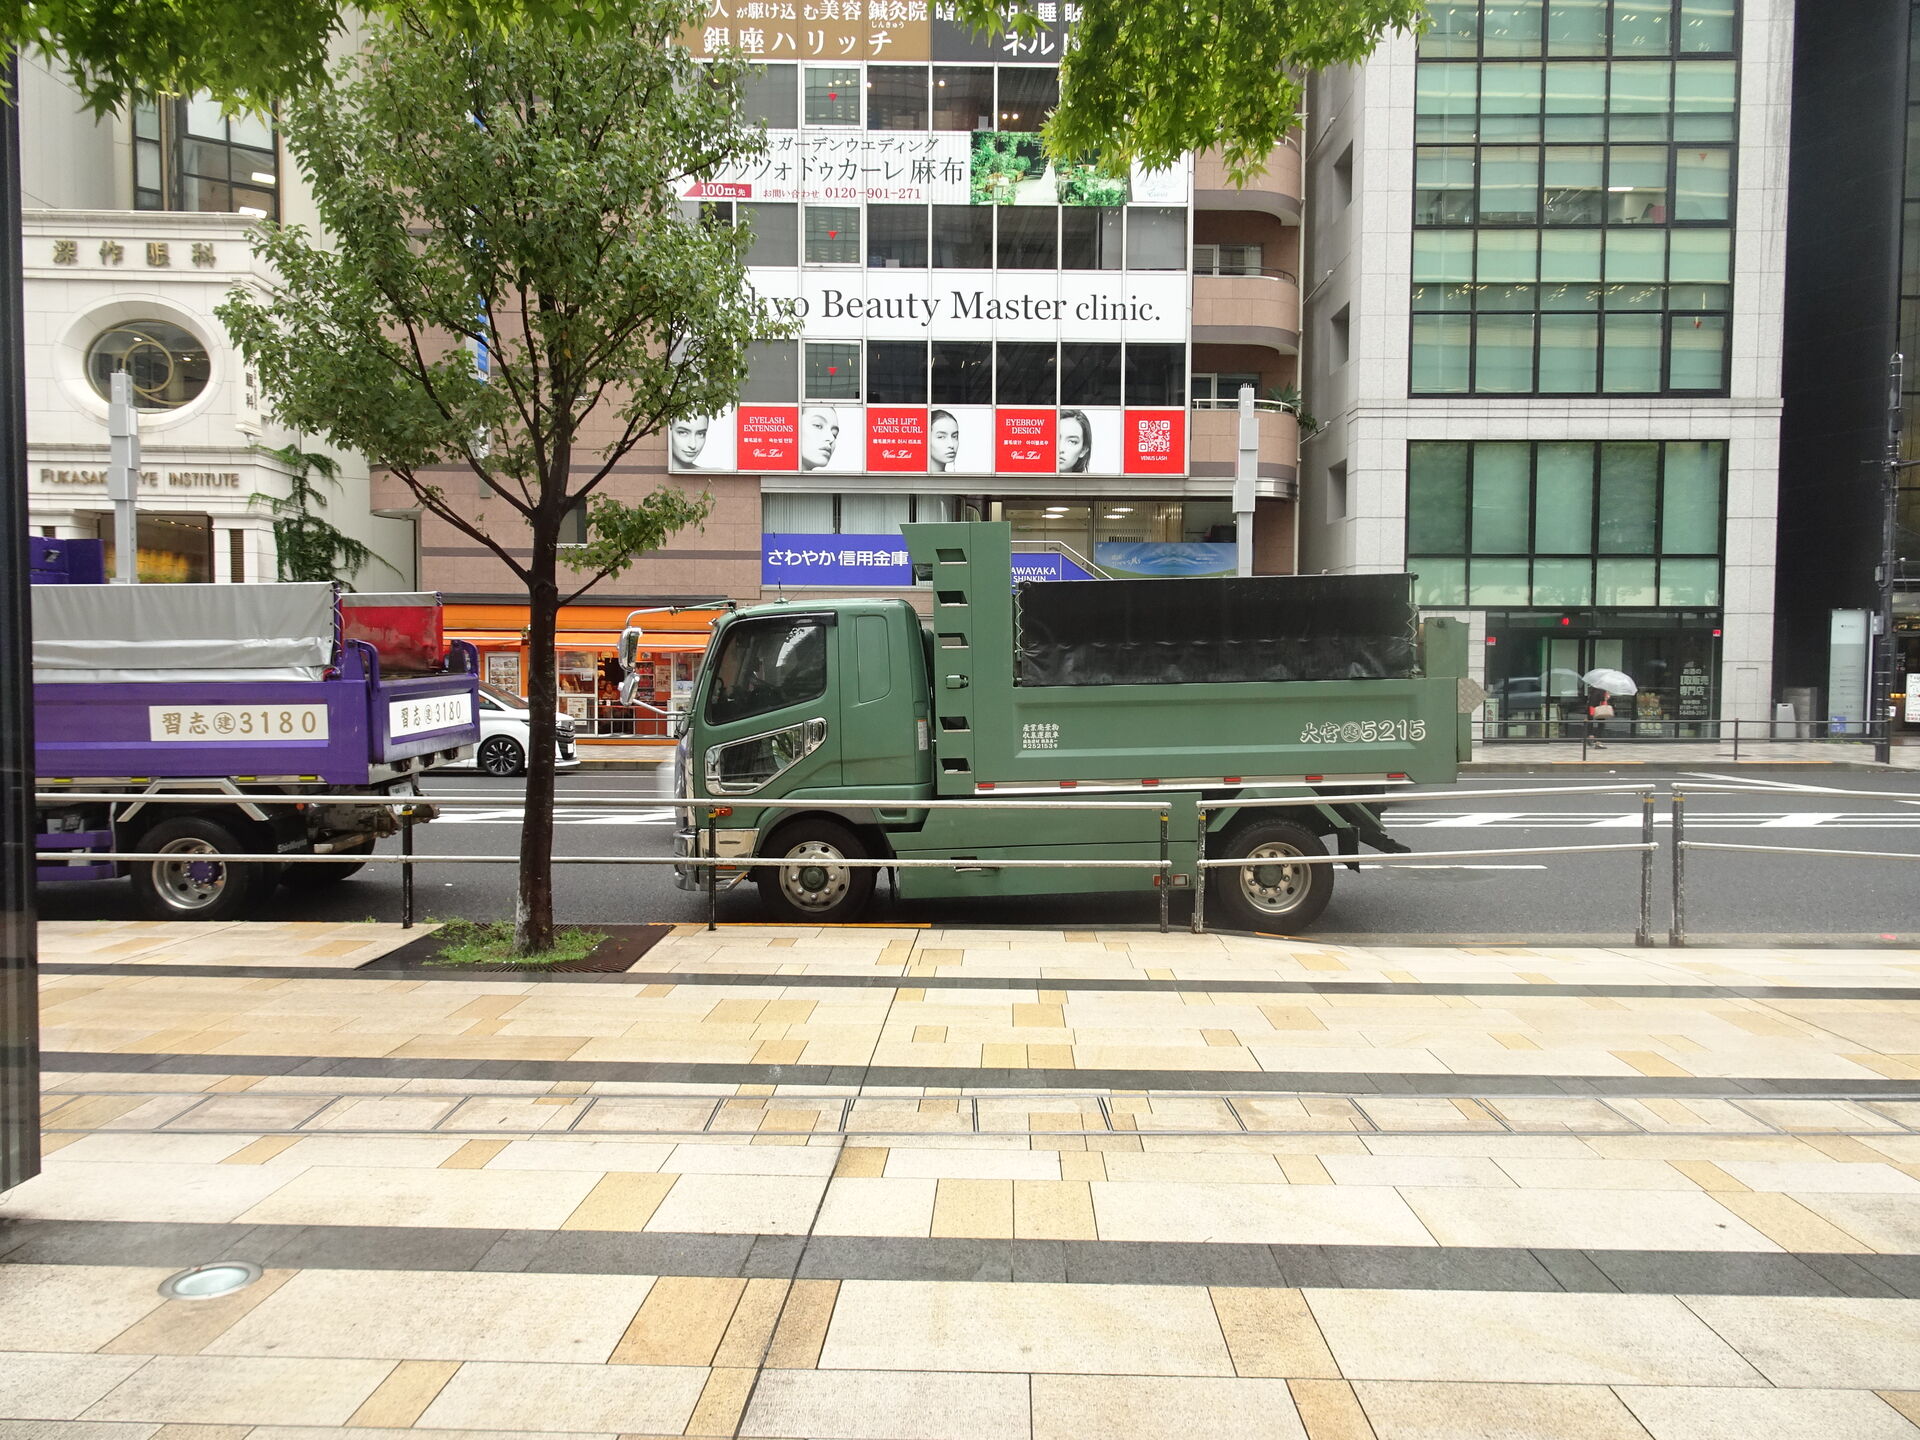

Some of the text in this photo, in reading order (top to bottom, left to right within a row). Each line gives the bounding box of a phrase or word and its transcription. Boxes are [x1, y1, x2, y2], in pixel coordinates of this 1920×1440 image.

[704, 0, 927, 22] 人が駆け込む美容鍼灸院
[704, 26, 892, 55] 銀座ハリッチ
[763, 187, 921, 199] お問い合わせ 0120-901-271
[822, 289, 940, 327] Beauty
[950, 290, 1067, 320] Master
[1075, 294, 1161, 322] clinic.
[749, 416, 785, 424] EYELASH
[877, 417, 898, 425] LASH
[1005, 418, 1045, 427] EYEBROW
[743, 425, 794, 433] EXTENSIONS
[872, 426, 923, 434] VENUS CURL
[1011, 427, 1041, 435] DESIGN
[40, 468, 108, 486] FUKASAK
[168, 472, 240, 489] INSTITUTE
[767, 549, 909, 567] さわやか信用金庫
[1010, 566, 1057, 576] AWAYAKA
